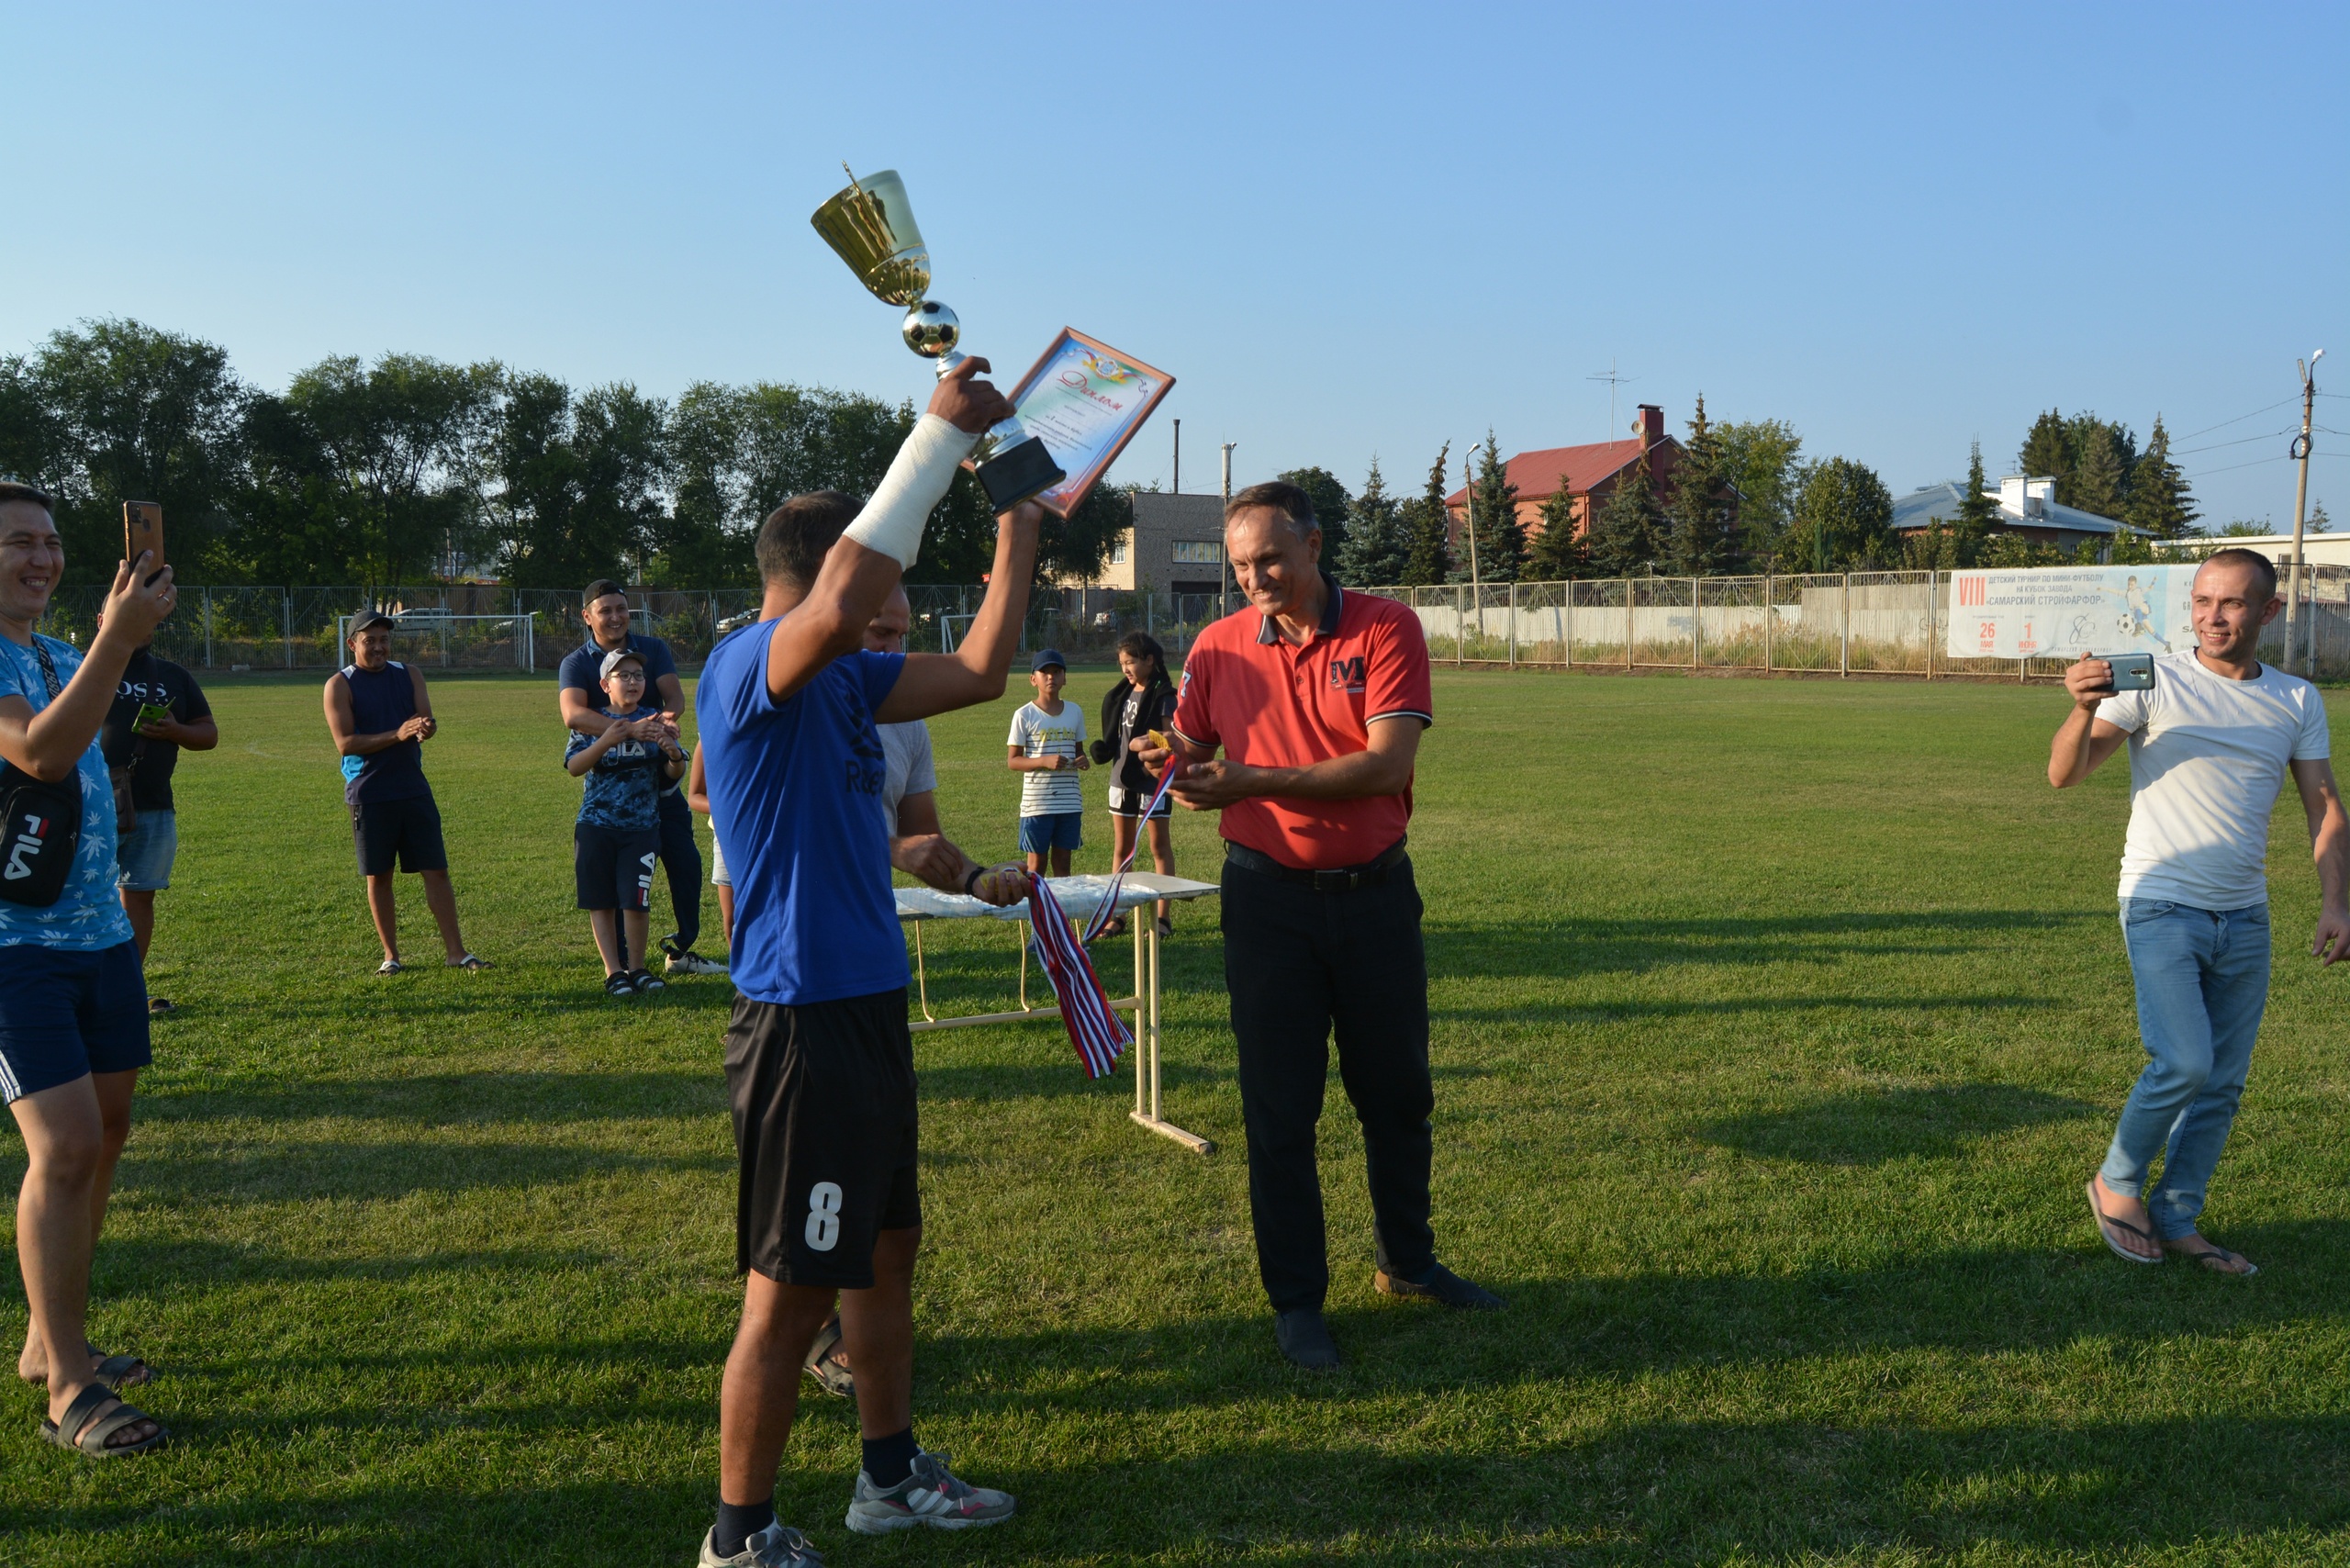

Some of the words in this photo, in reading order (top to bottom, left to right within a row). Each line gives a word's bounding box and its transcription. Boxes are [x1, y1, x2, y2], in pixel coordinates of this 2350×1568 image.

[1058, 370, 1125, 411] Диплом
[1988, 576, 2016, 585] ДЕТСКИЙ
[2018, 575, 2041, 583] ТУРНИР
[2042, 575, 2051, 583] ПО
[2052, 574, 2104, 583] МИНИ-ФУТБОЛУ
[1959, 577, 1986, 606] VIII
[2047, 585, 2073, 593] ЗАВОДА
[1986, 595, 2035, 606] «САМАРСКИЙ
[2038, 593, 2105, 606] СТРОЙФАРФОР»
[1979, 622, 1996, 639] 26
[2023, 622, 2031, 639] 1
[1980, 640, 1994, 648] МАЯ
[2018, 640, 2037, 649] ИЮНЯ
[117, 680, 167, 698] OSS
[5, 814, 50, 880] FILA
[638, 852, 655, 907] FILA
[805, 1182, 843, 1251] 8
